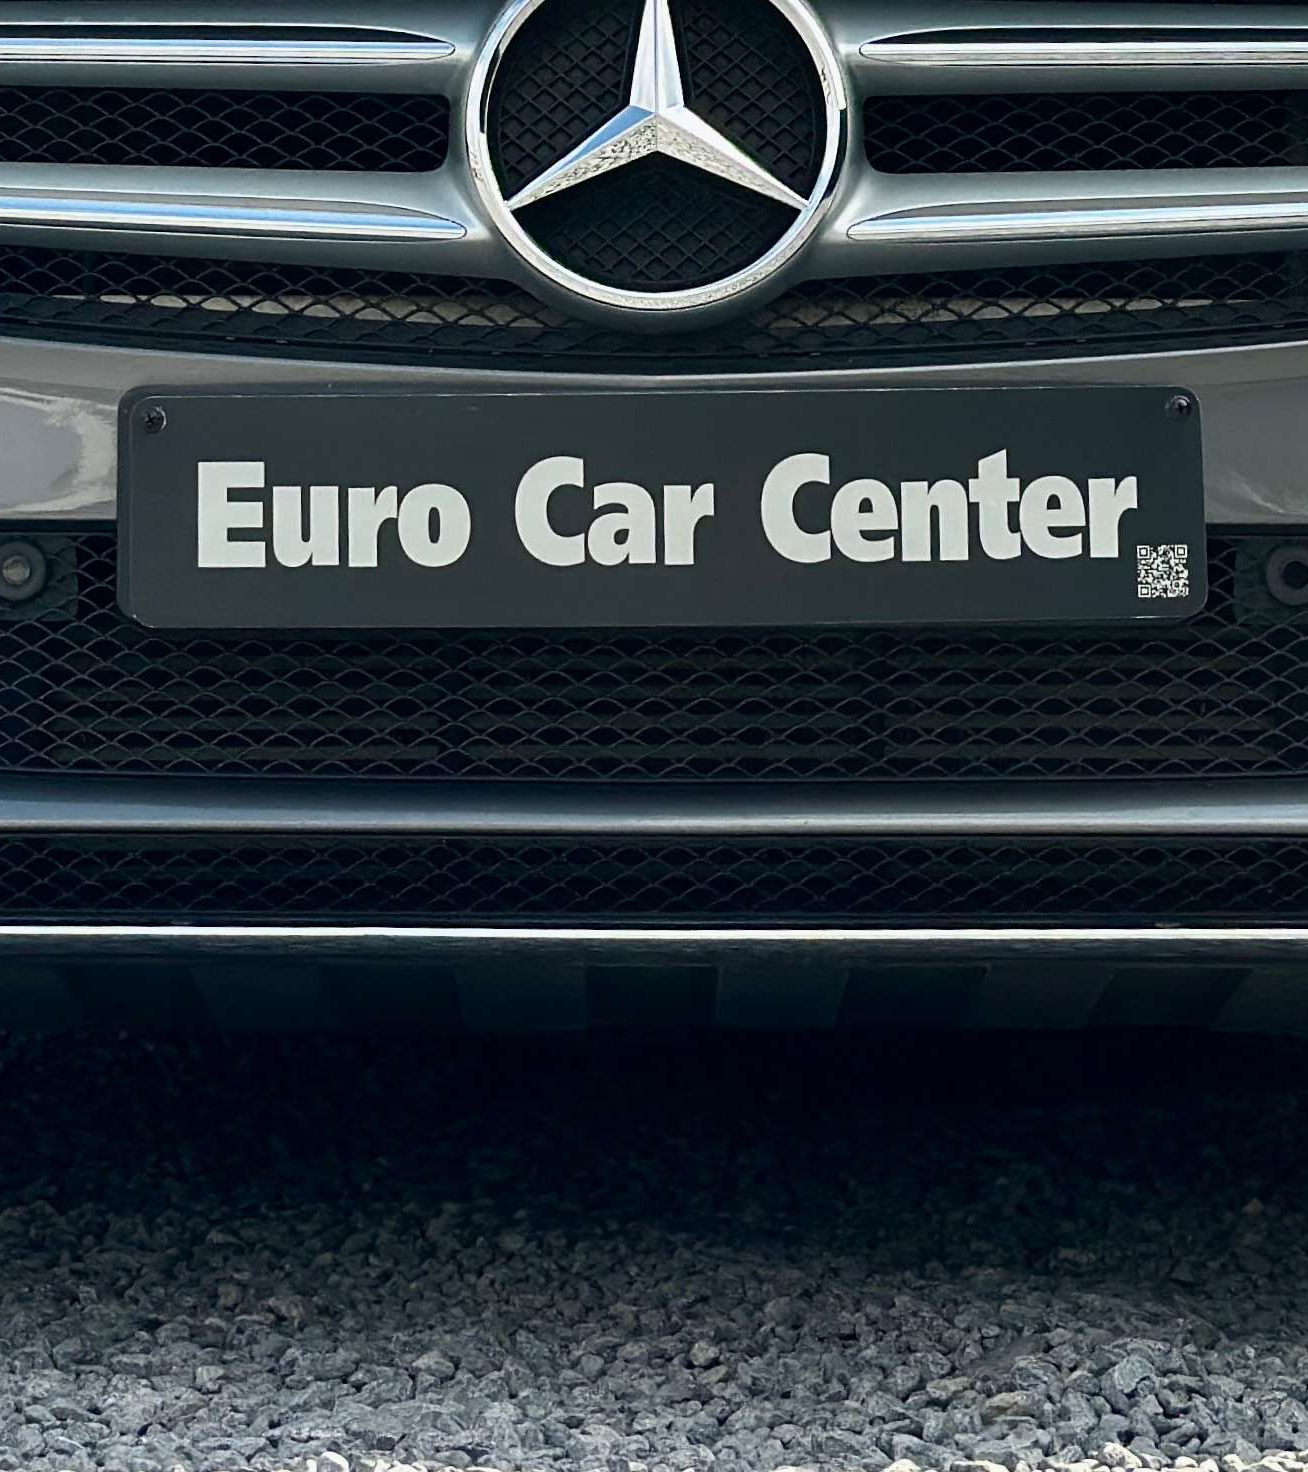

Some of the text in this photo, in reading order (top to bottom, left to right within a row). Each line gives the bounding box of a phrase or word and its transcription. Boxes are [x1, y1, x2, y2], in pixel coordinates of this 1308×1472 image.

[197, 448, 1138, 568] Euro Car Center
